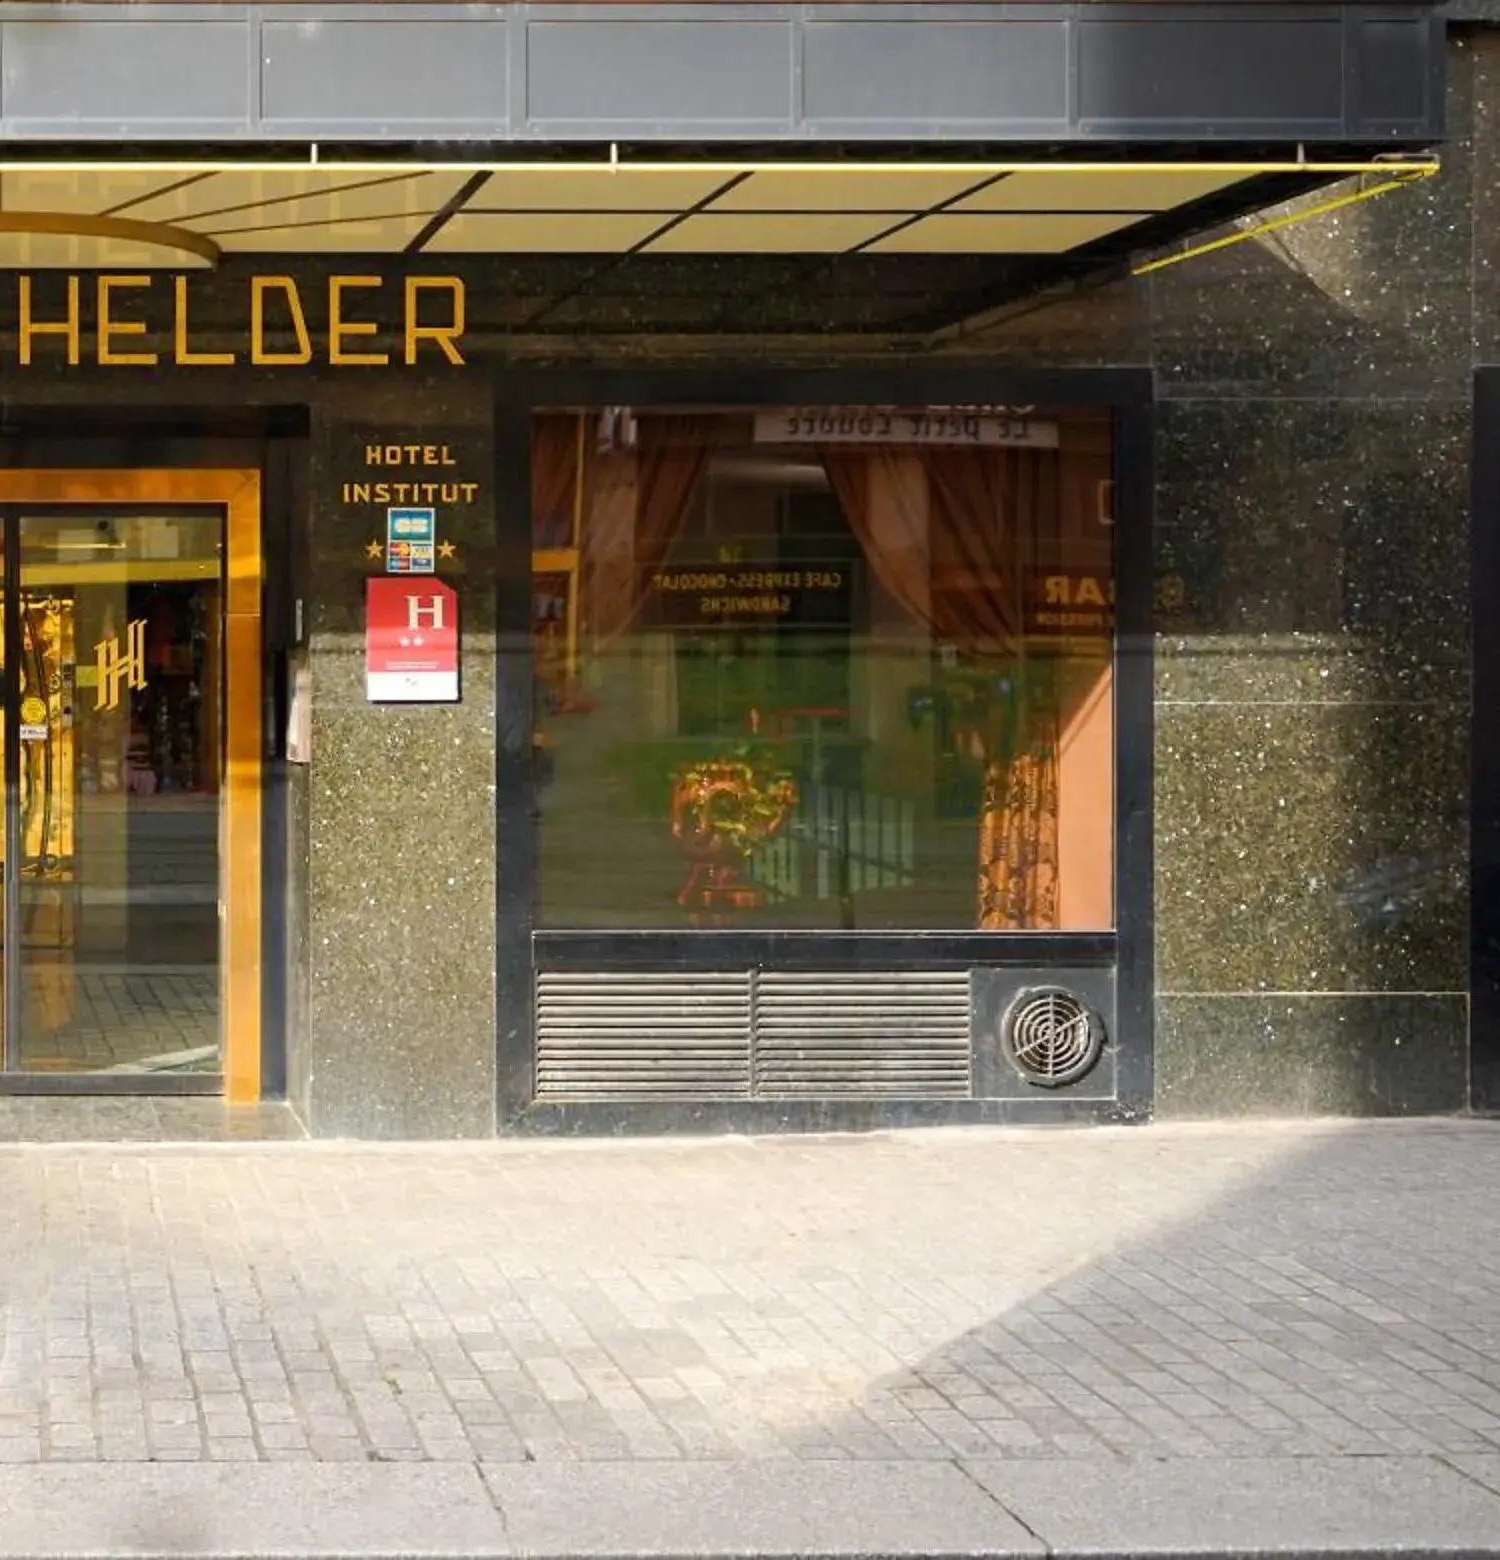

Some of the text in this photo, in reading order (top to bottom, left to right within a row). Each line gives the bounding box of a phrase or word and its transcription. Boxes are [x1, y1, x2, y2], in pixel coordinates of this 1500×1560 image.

[19, 275, 465, 365] HELDER
[366, 445, 456, 465] HOTEL
[343, 483, 479, 503] INSTITUT
[406, 594, 445, 630] H
